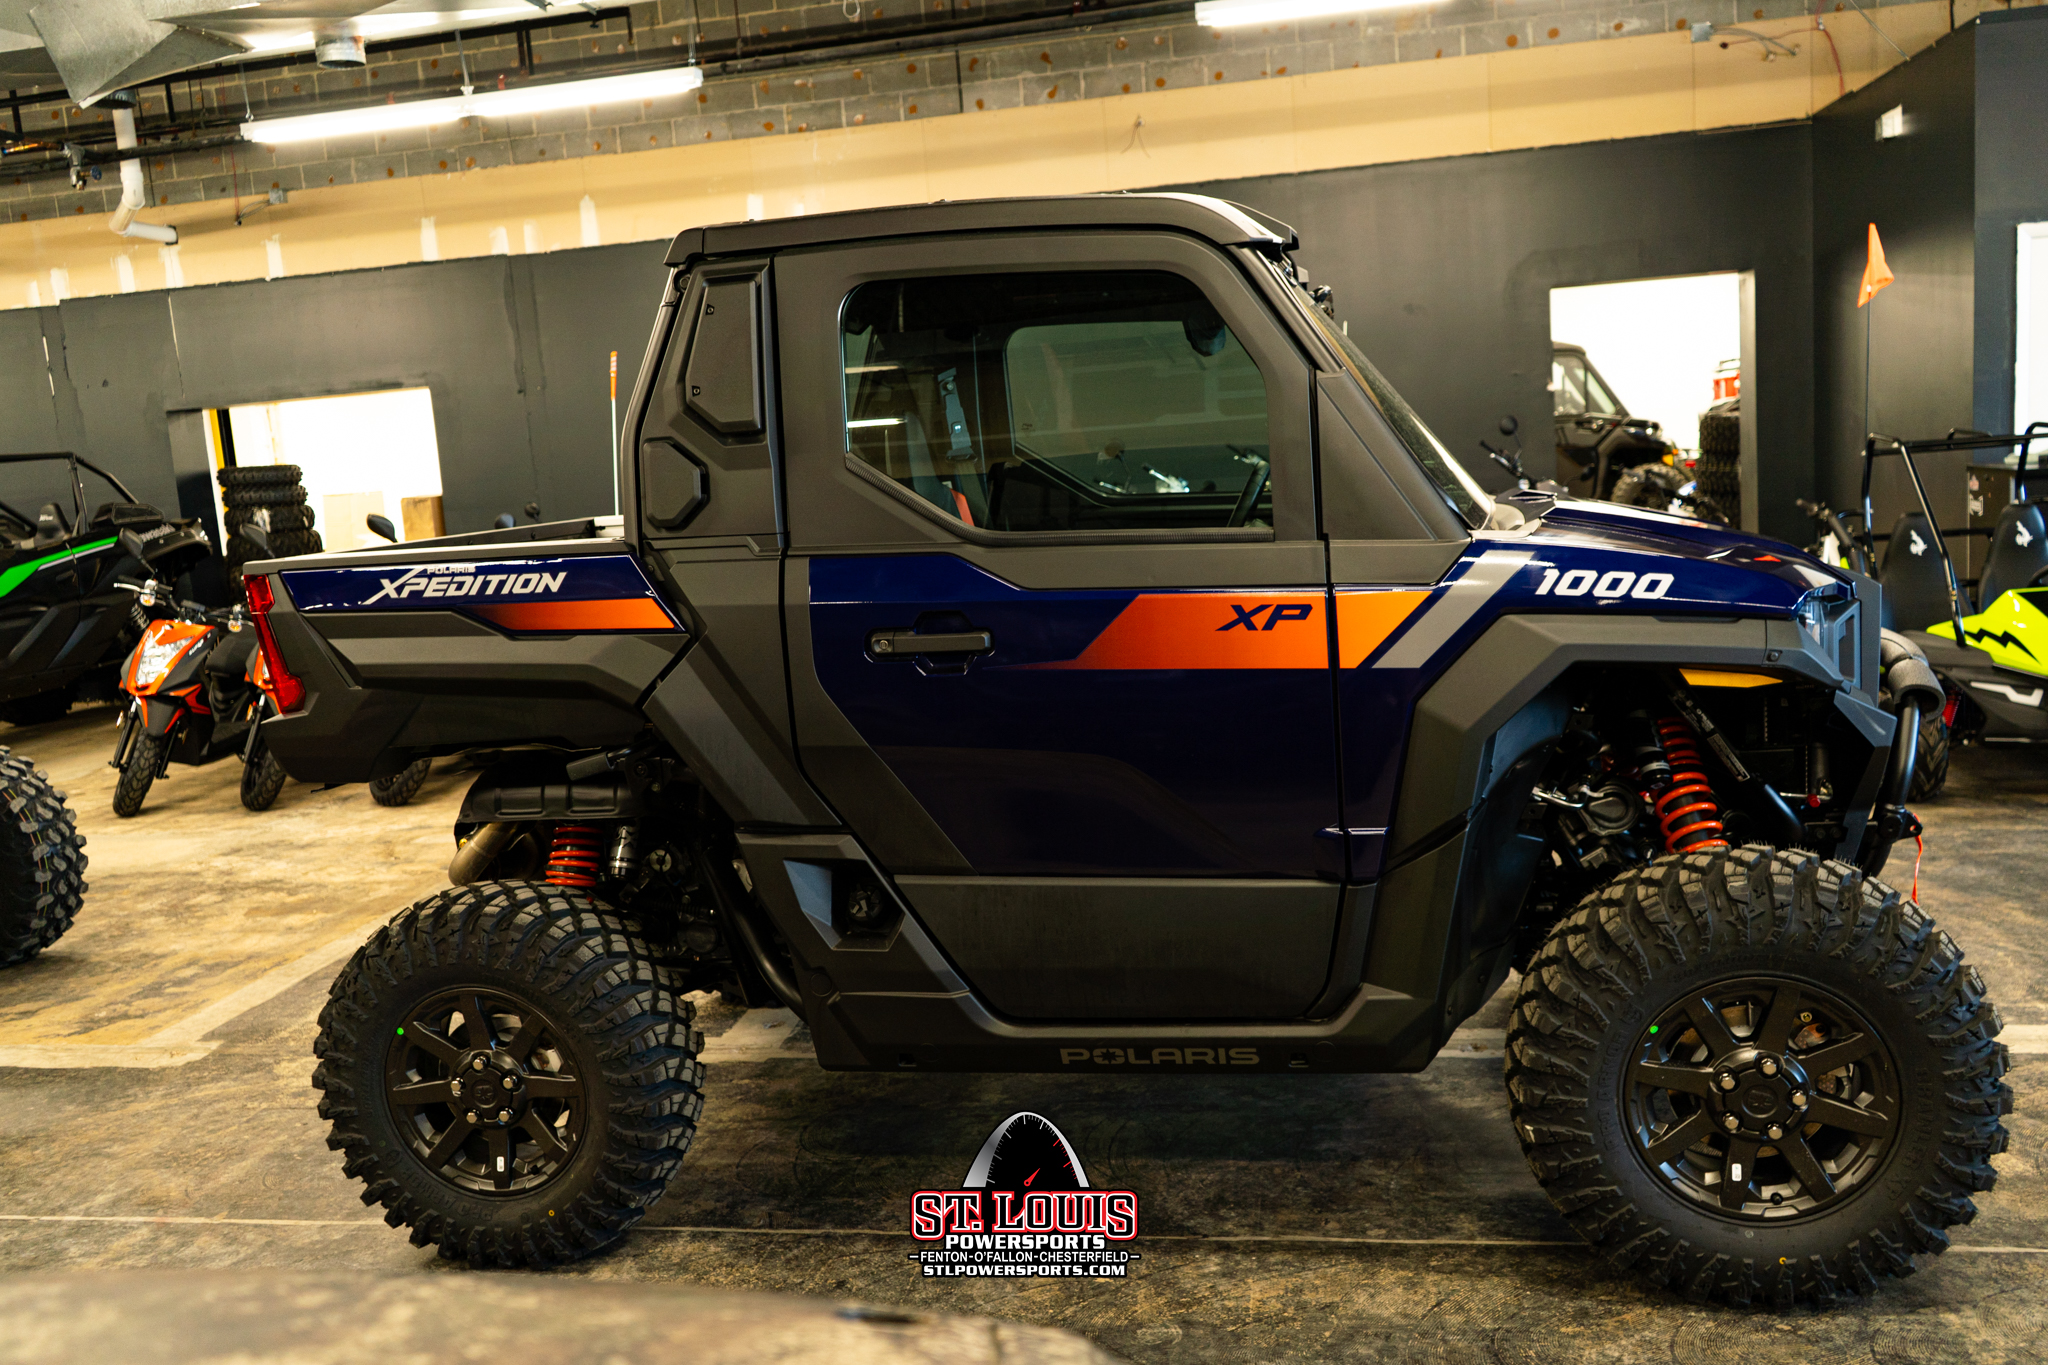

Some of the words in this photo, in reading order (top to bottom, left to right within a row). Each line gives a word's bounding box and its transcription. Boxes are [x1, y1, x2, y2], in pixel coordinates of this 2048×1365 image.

[427, 566, 477, 575] POLARIS
[1534, 568, 1675, 600] 1000
[361, 567, 568, 606] XPEDITION
[1214, 603, 1314, 632] XP
[1059, 1048, 1261, 1065] POLARIS
